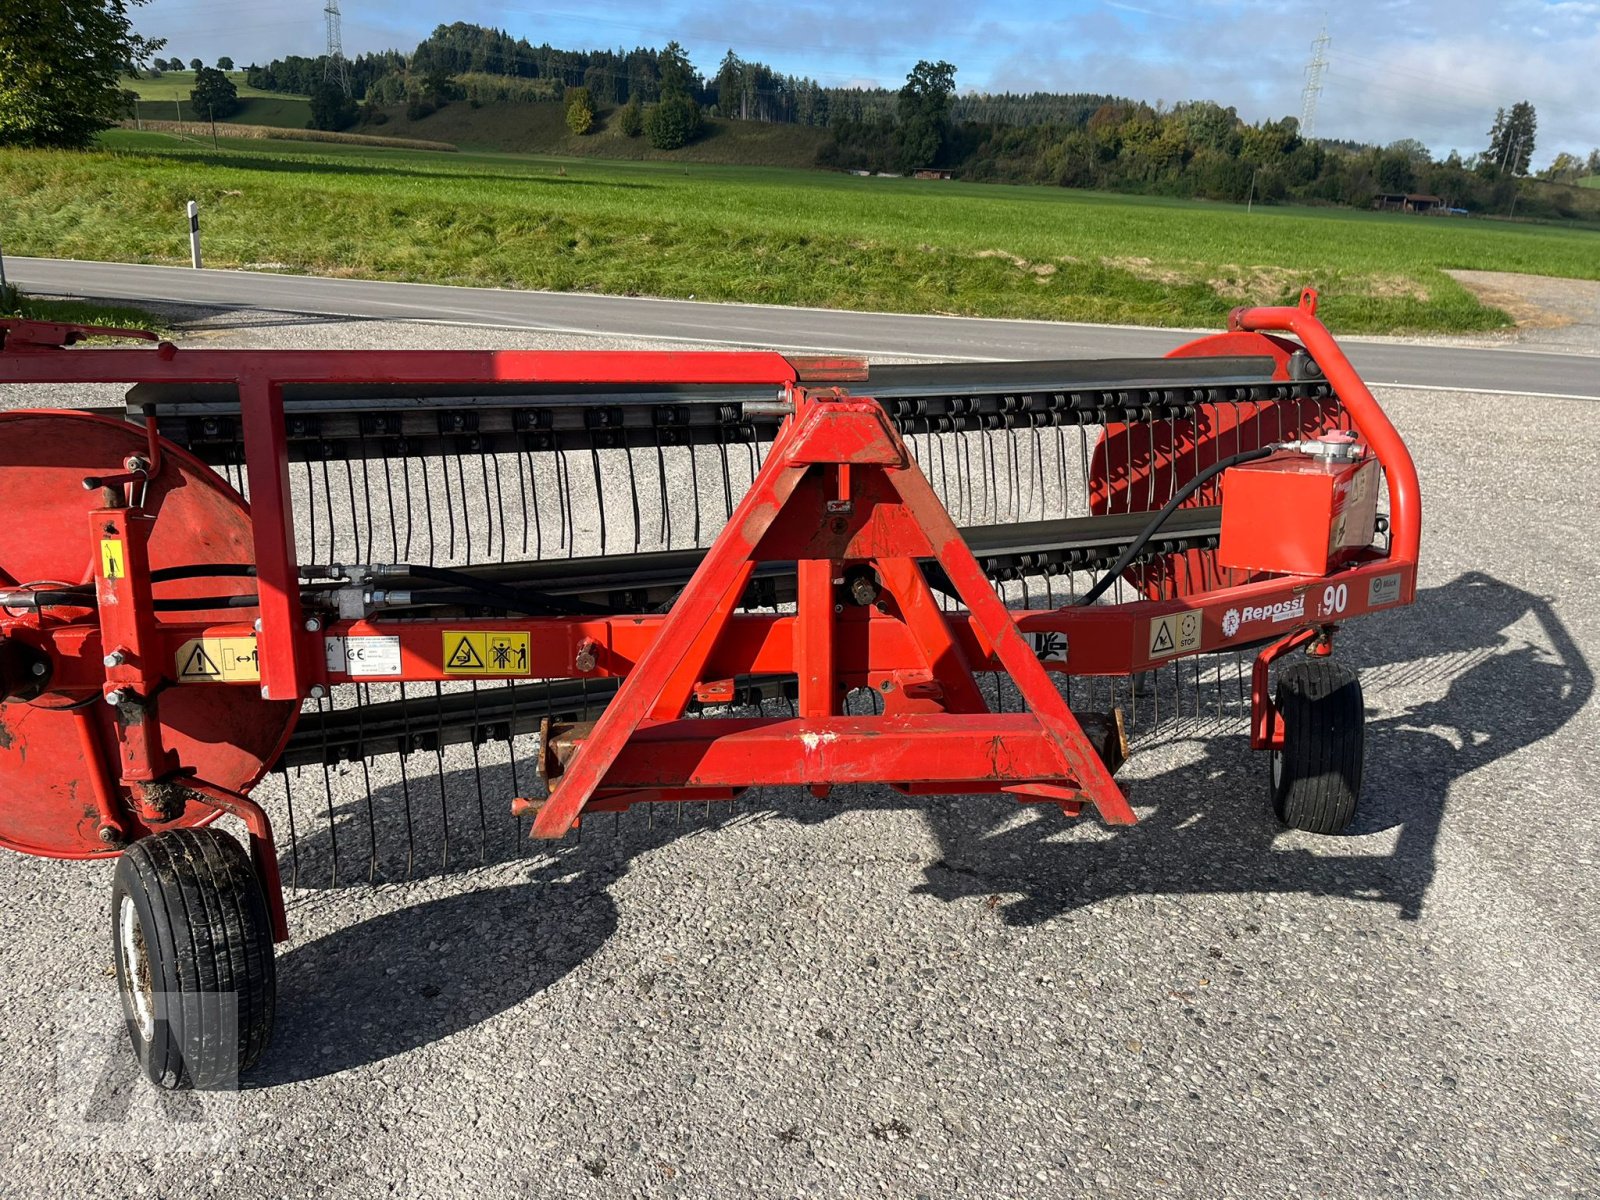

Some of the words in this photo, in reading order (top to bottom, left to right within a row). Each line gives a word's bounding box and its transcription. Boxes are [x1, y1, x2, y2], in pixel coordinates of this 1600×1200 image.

[1241, 594, 1305, 622] Repossi
[1323, 583, 1348, 616] 90
[1180, 637, 1196, 648] STOP
